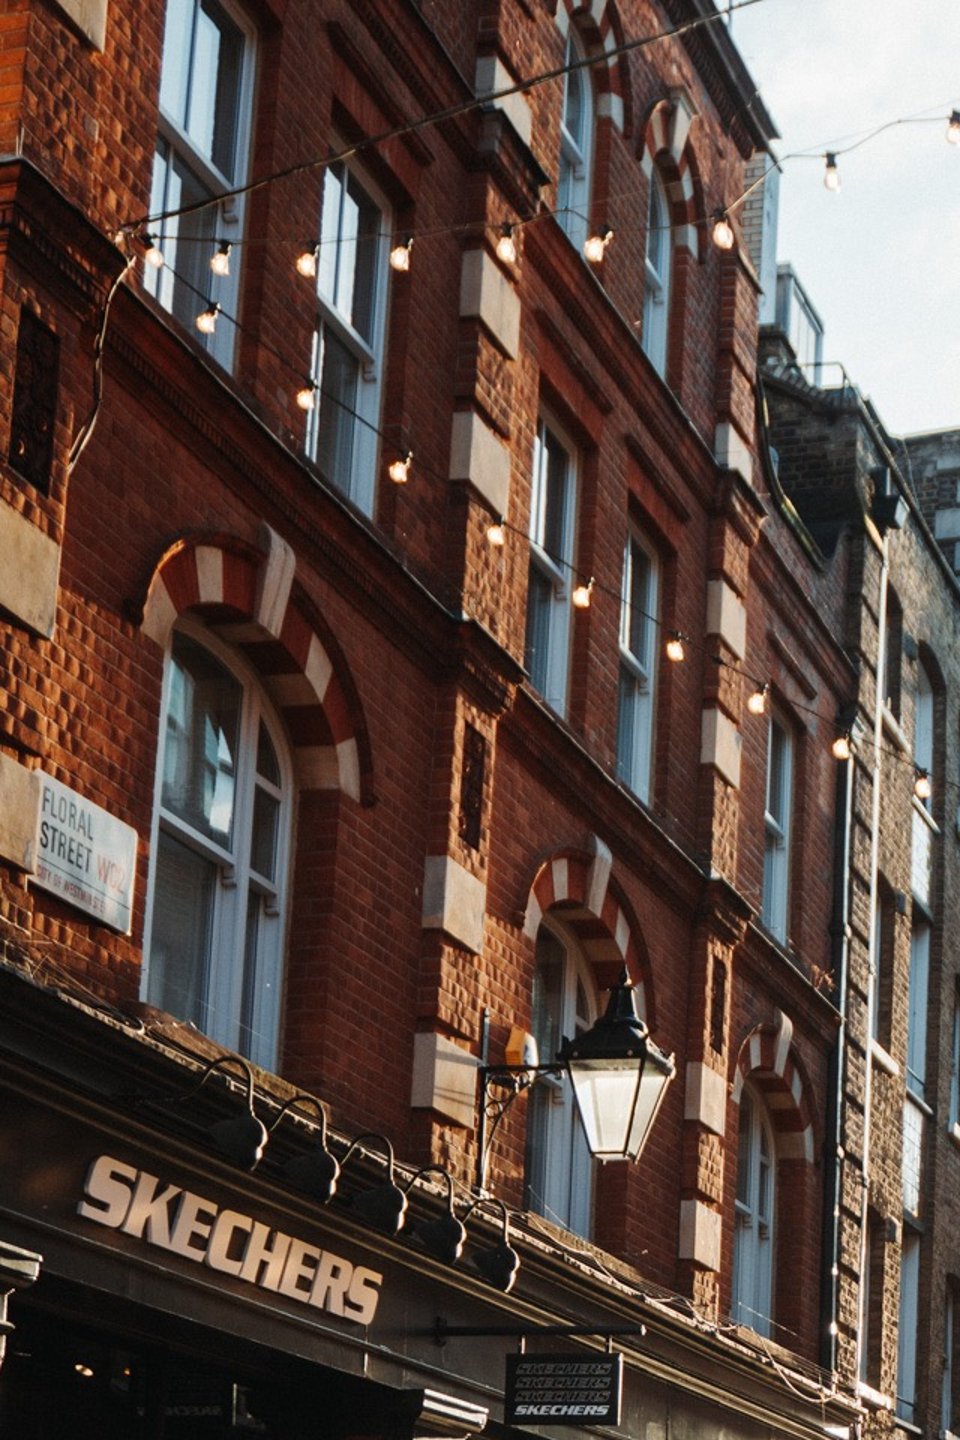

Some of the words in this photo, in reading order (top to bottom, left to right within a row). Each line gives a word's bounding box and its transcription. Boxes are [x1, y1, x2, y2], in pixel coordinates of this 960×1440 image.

[41, 786, 94, 841] FLORAL
[39, 821, 94, 874] STREET
[96, 854, 125, 894] WC2
[77, 1155, 384, 1326] SKECHERS
[515, 1363, 613, 1375] SKECHERS
[514, 1377, 612, 1389] SKECHERS
[514, 1390, 611, 1402] SKECHERS
[513, 1404, 610, 1416] SKECHERS
